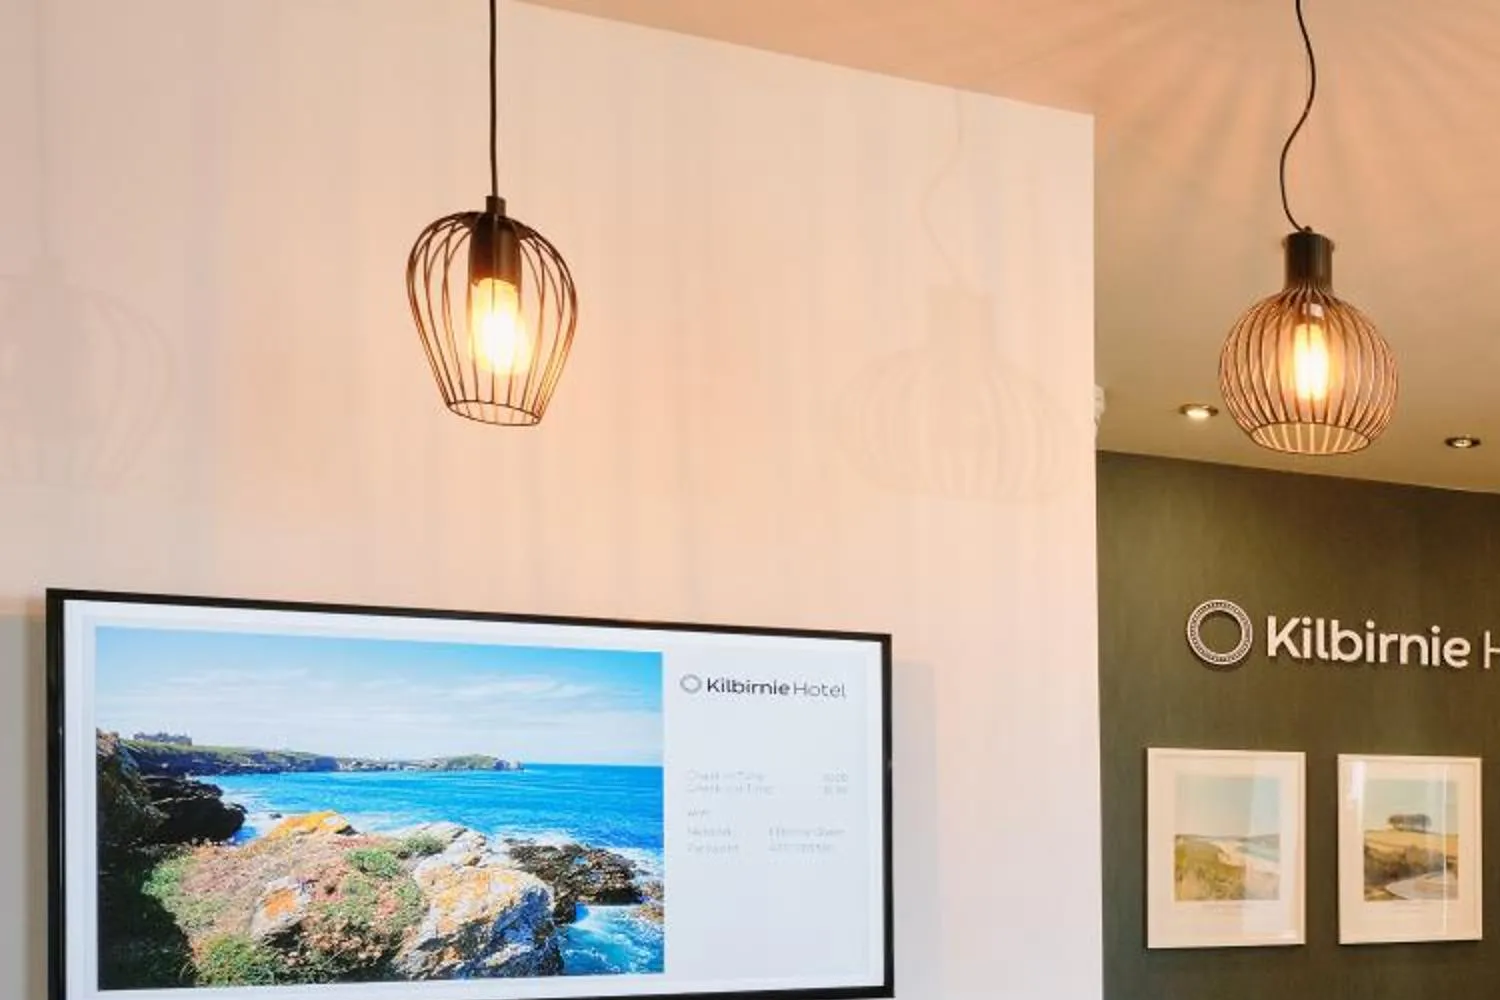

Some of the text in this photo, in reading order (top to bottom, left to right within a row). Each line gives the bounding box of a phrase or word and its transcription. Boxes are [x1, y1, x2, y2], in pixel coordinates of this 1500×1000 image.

[1266, 614, 1471, 669] Kilbirnie
[706, 676, 847, 699] Kilbirnie Hotel
